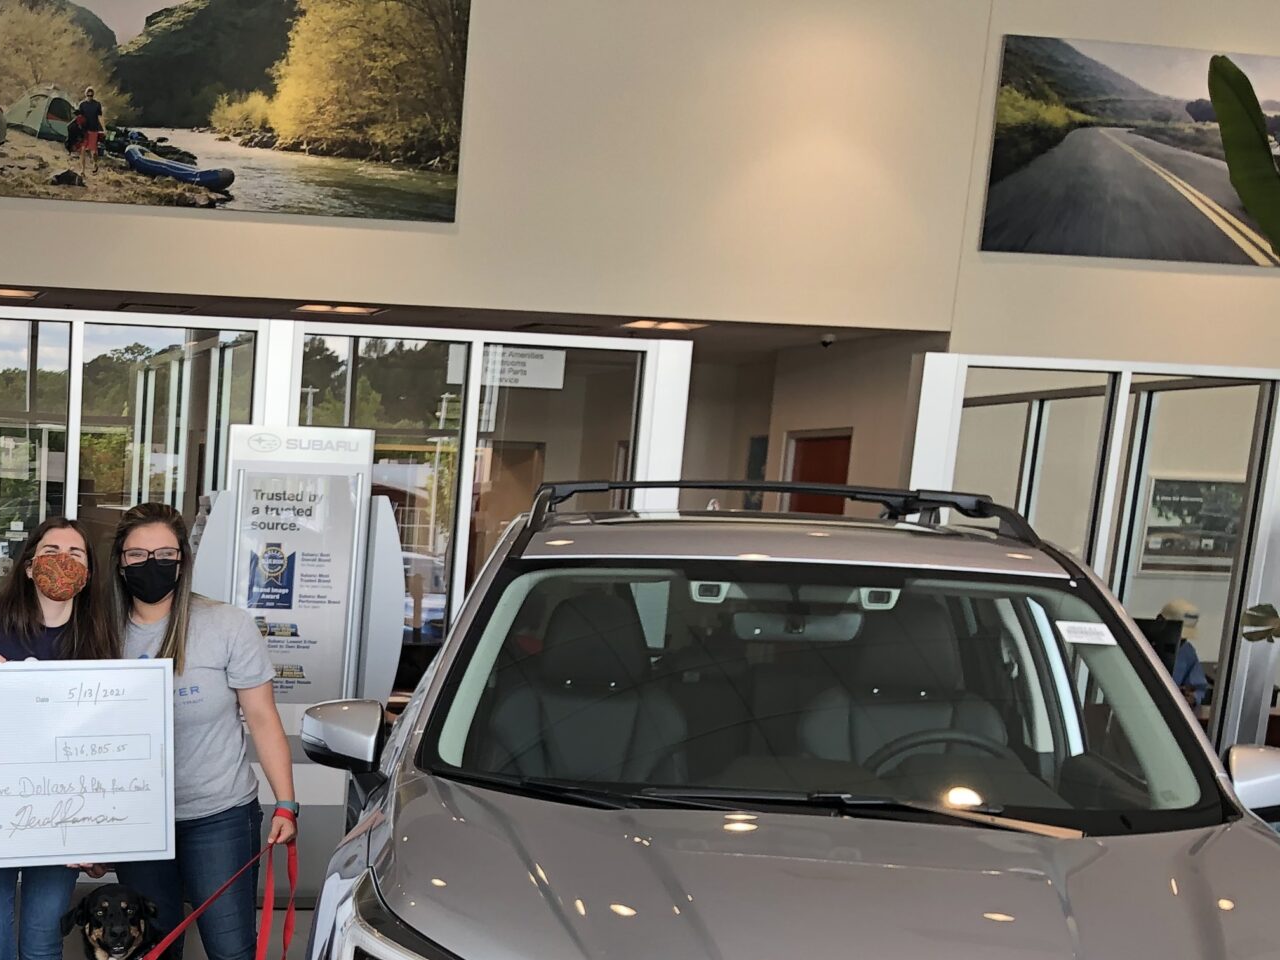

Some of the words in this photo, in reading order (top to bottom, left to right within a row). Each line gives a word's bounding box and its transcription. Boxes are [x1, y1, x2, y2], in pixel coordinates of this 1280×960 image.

[286, 438, 359, 452] SUBARU
[253, 489, 304, 502] Trusted
[251, 506, 260, 515] a
[251, 520, 300, 531] source.
[19, 776, 75, 797] Dollars
